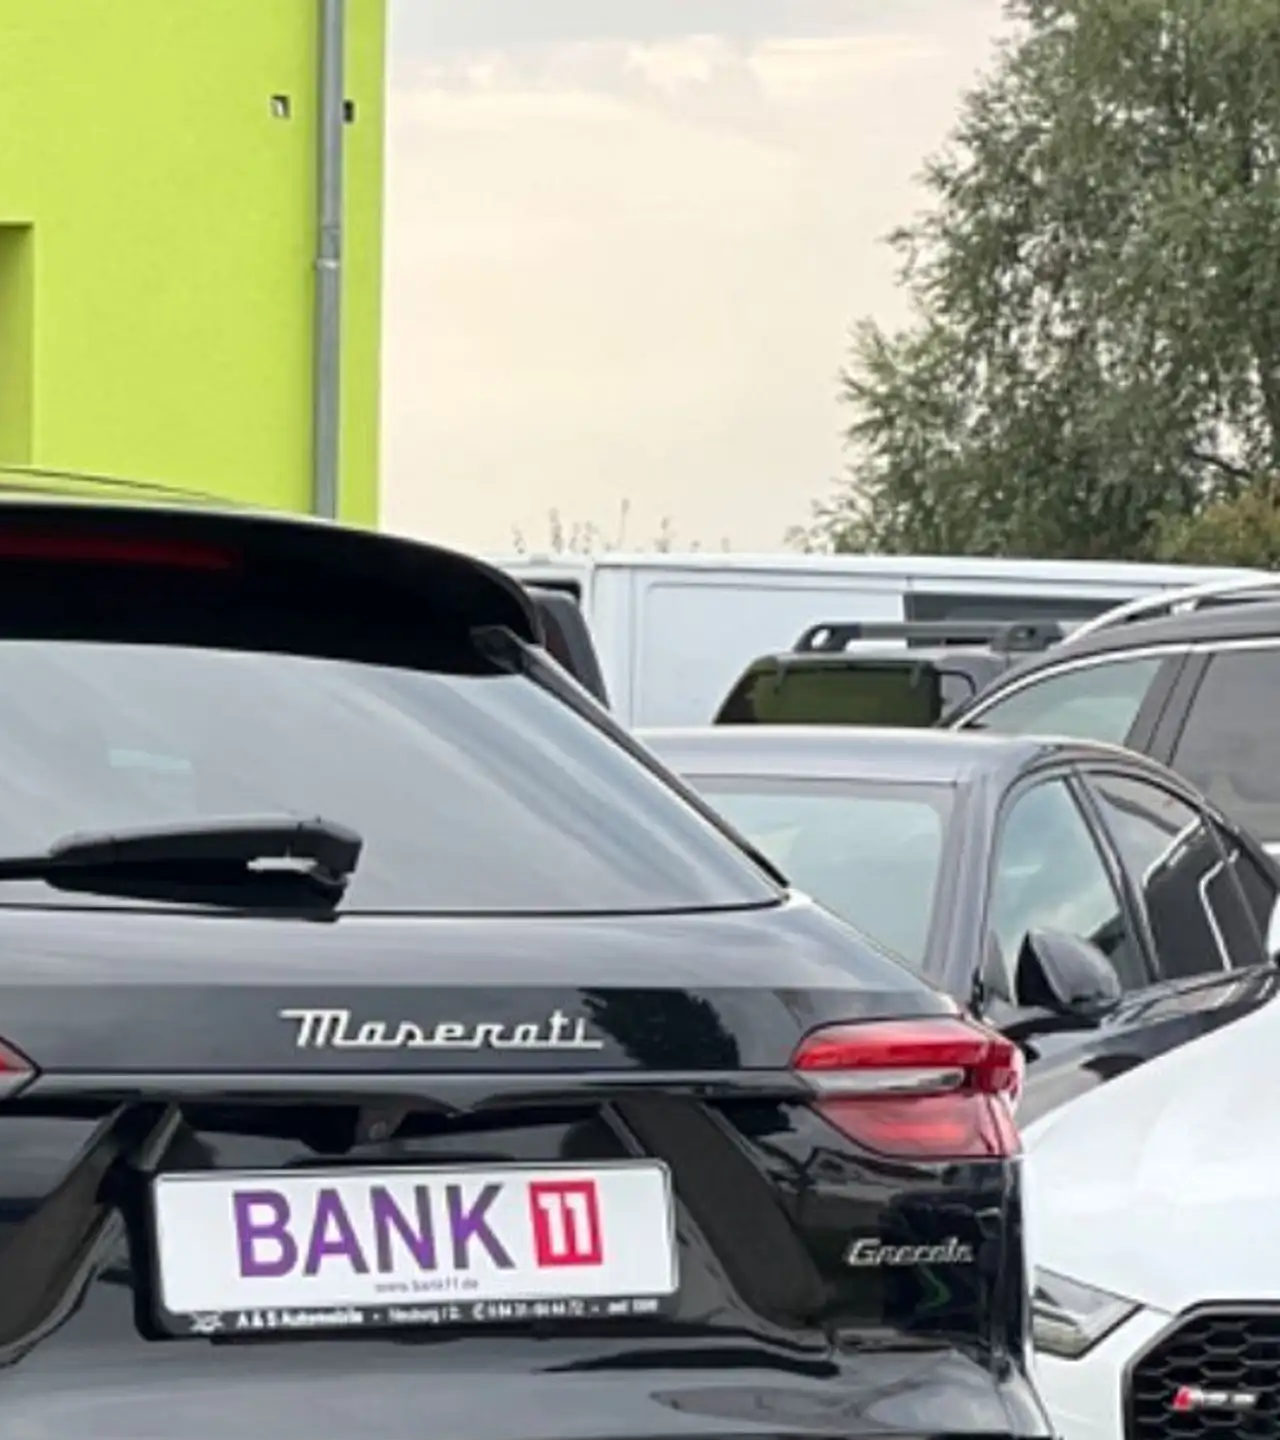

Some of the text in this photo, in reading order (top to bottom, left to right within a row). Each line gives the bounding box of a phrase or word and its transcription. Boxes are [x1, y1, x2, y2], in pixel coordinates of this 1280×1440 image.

[278, 1009, 604, 1049] Maserati
[232, 1181, 594, 1278] BANK 11
